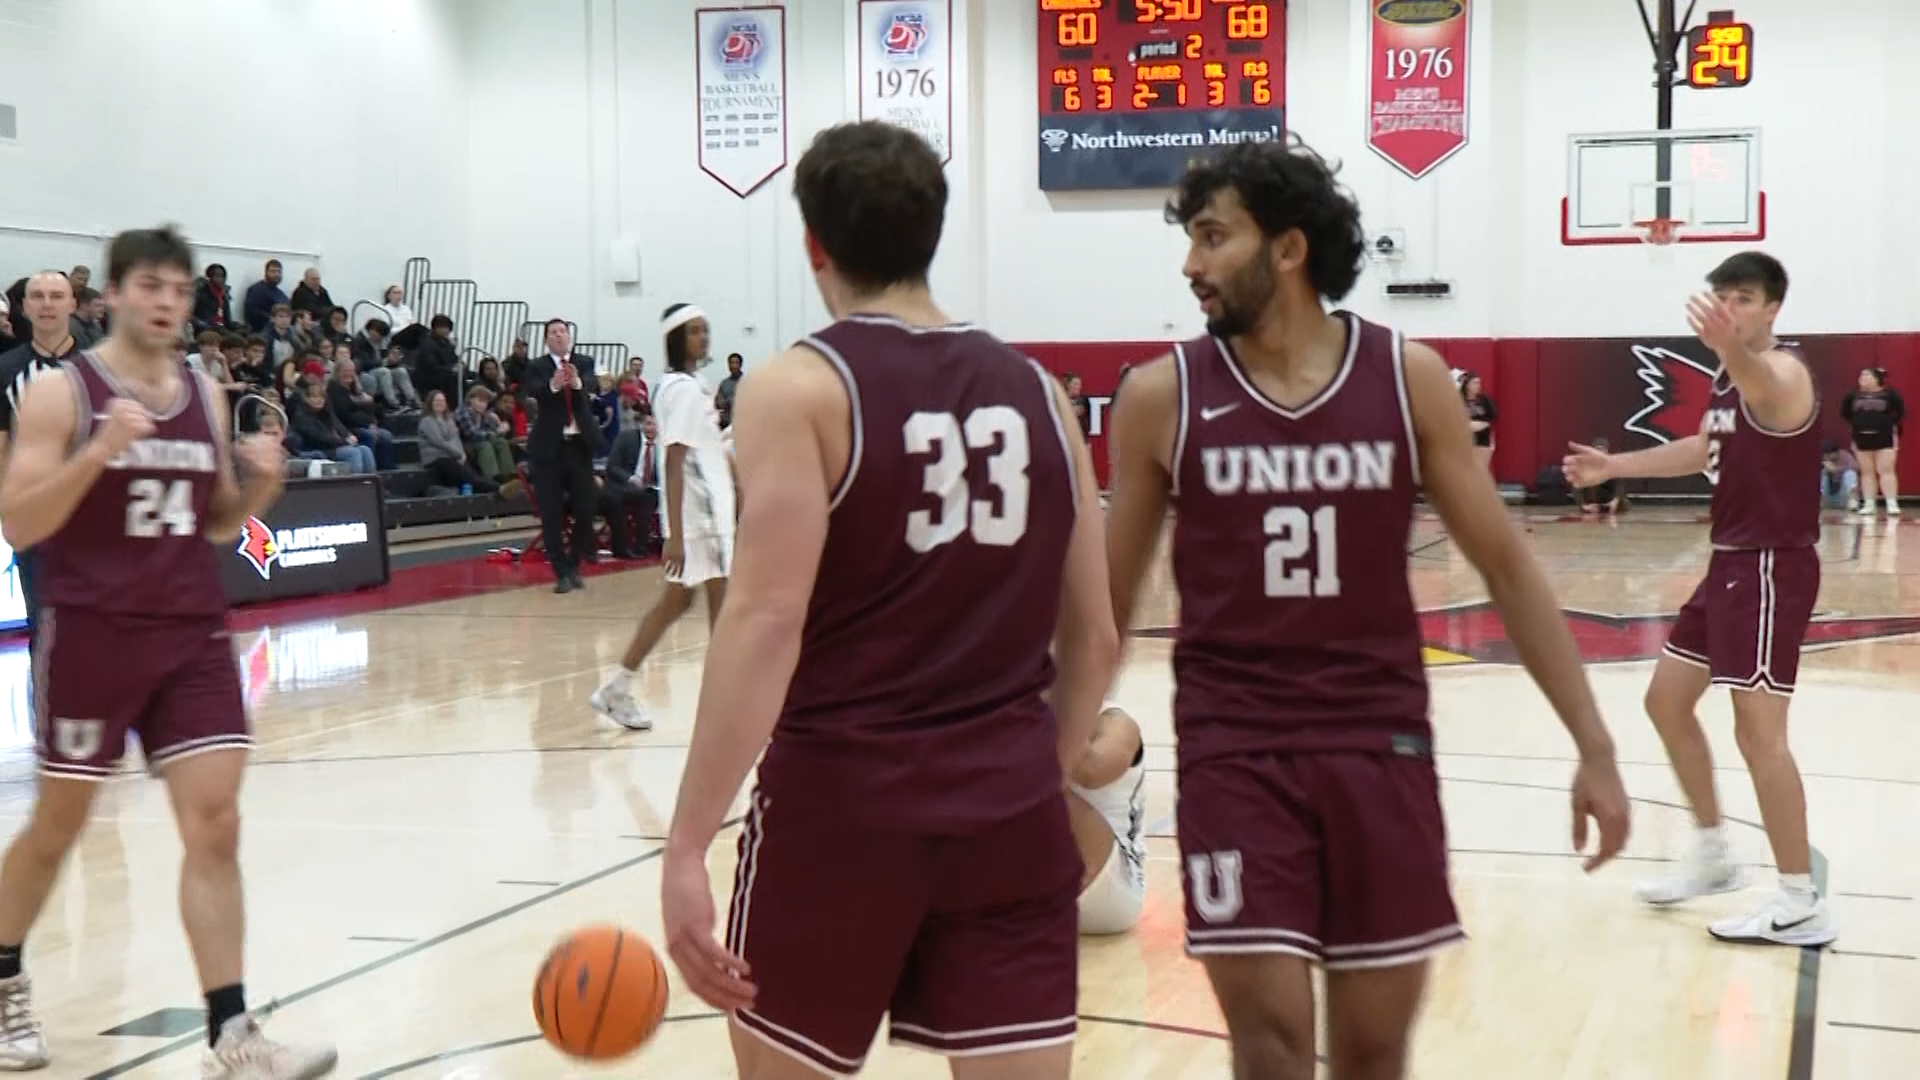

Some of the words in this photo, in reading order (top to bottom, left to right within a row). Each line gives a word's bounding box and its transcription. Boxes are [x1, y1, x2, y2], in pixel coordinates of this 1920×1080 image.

[1058, 13, 1097, 46] 60
[1227, 5, 1268, 39] 68
[1140, 41, 1178, 58] period
[1186, 34, 1202, 58] 2
[1053, 68, 1077, 84] FLS
[1243, 61, 1269, 77] FLS
[1385, 47, 1453, 80] 1976
[1692, 44, 1747, 84] 24
[874, 69, 936, 98] 1976
[1064, 86, 1081, 110] 6
[1096, 85, 1112, 109] 3
[1208, 81, 1225, 106] 3
[1253, 79, 1271, 105] 6
[1072, 130, 1204, 150] Northwestern
[105, 438, 216, 473] NION
[1202, 441, 1395, 494] UNION
[903, 405, 1031, 554] 33
[125, 478, 197, 538] 24
[1263, 506, 1341, 597] 21
[54, 718, 105, 760] U
[1187, 850, 1244, 923] U
